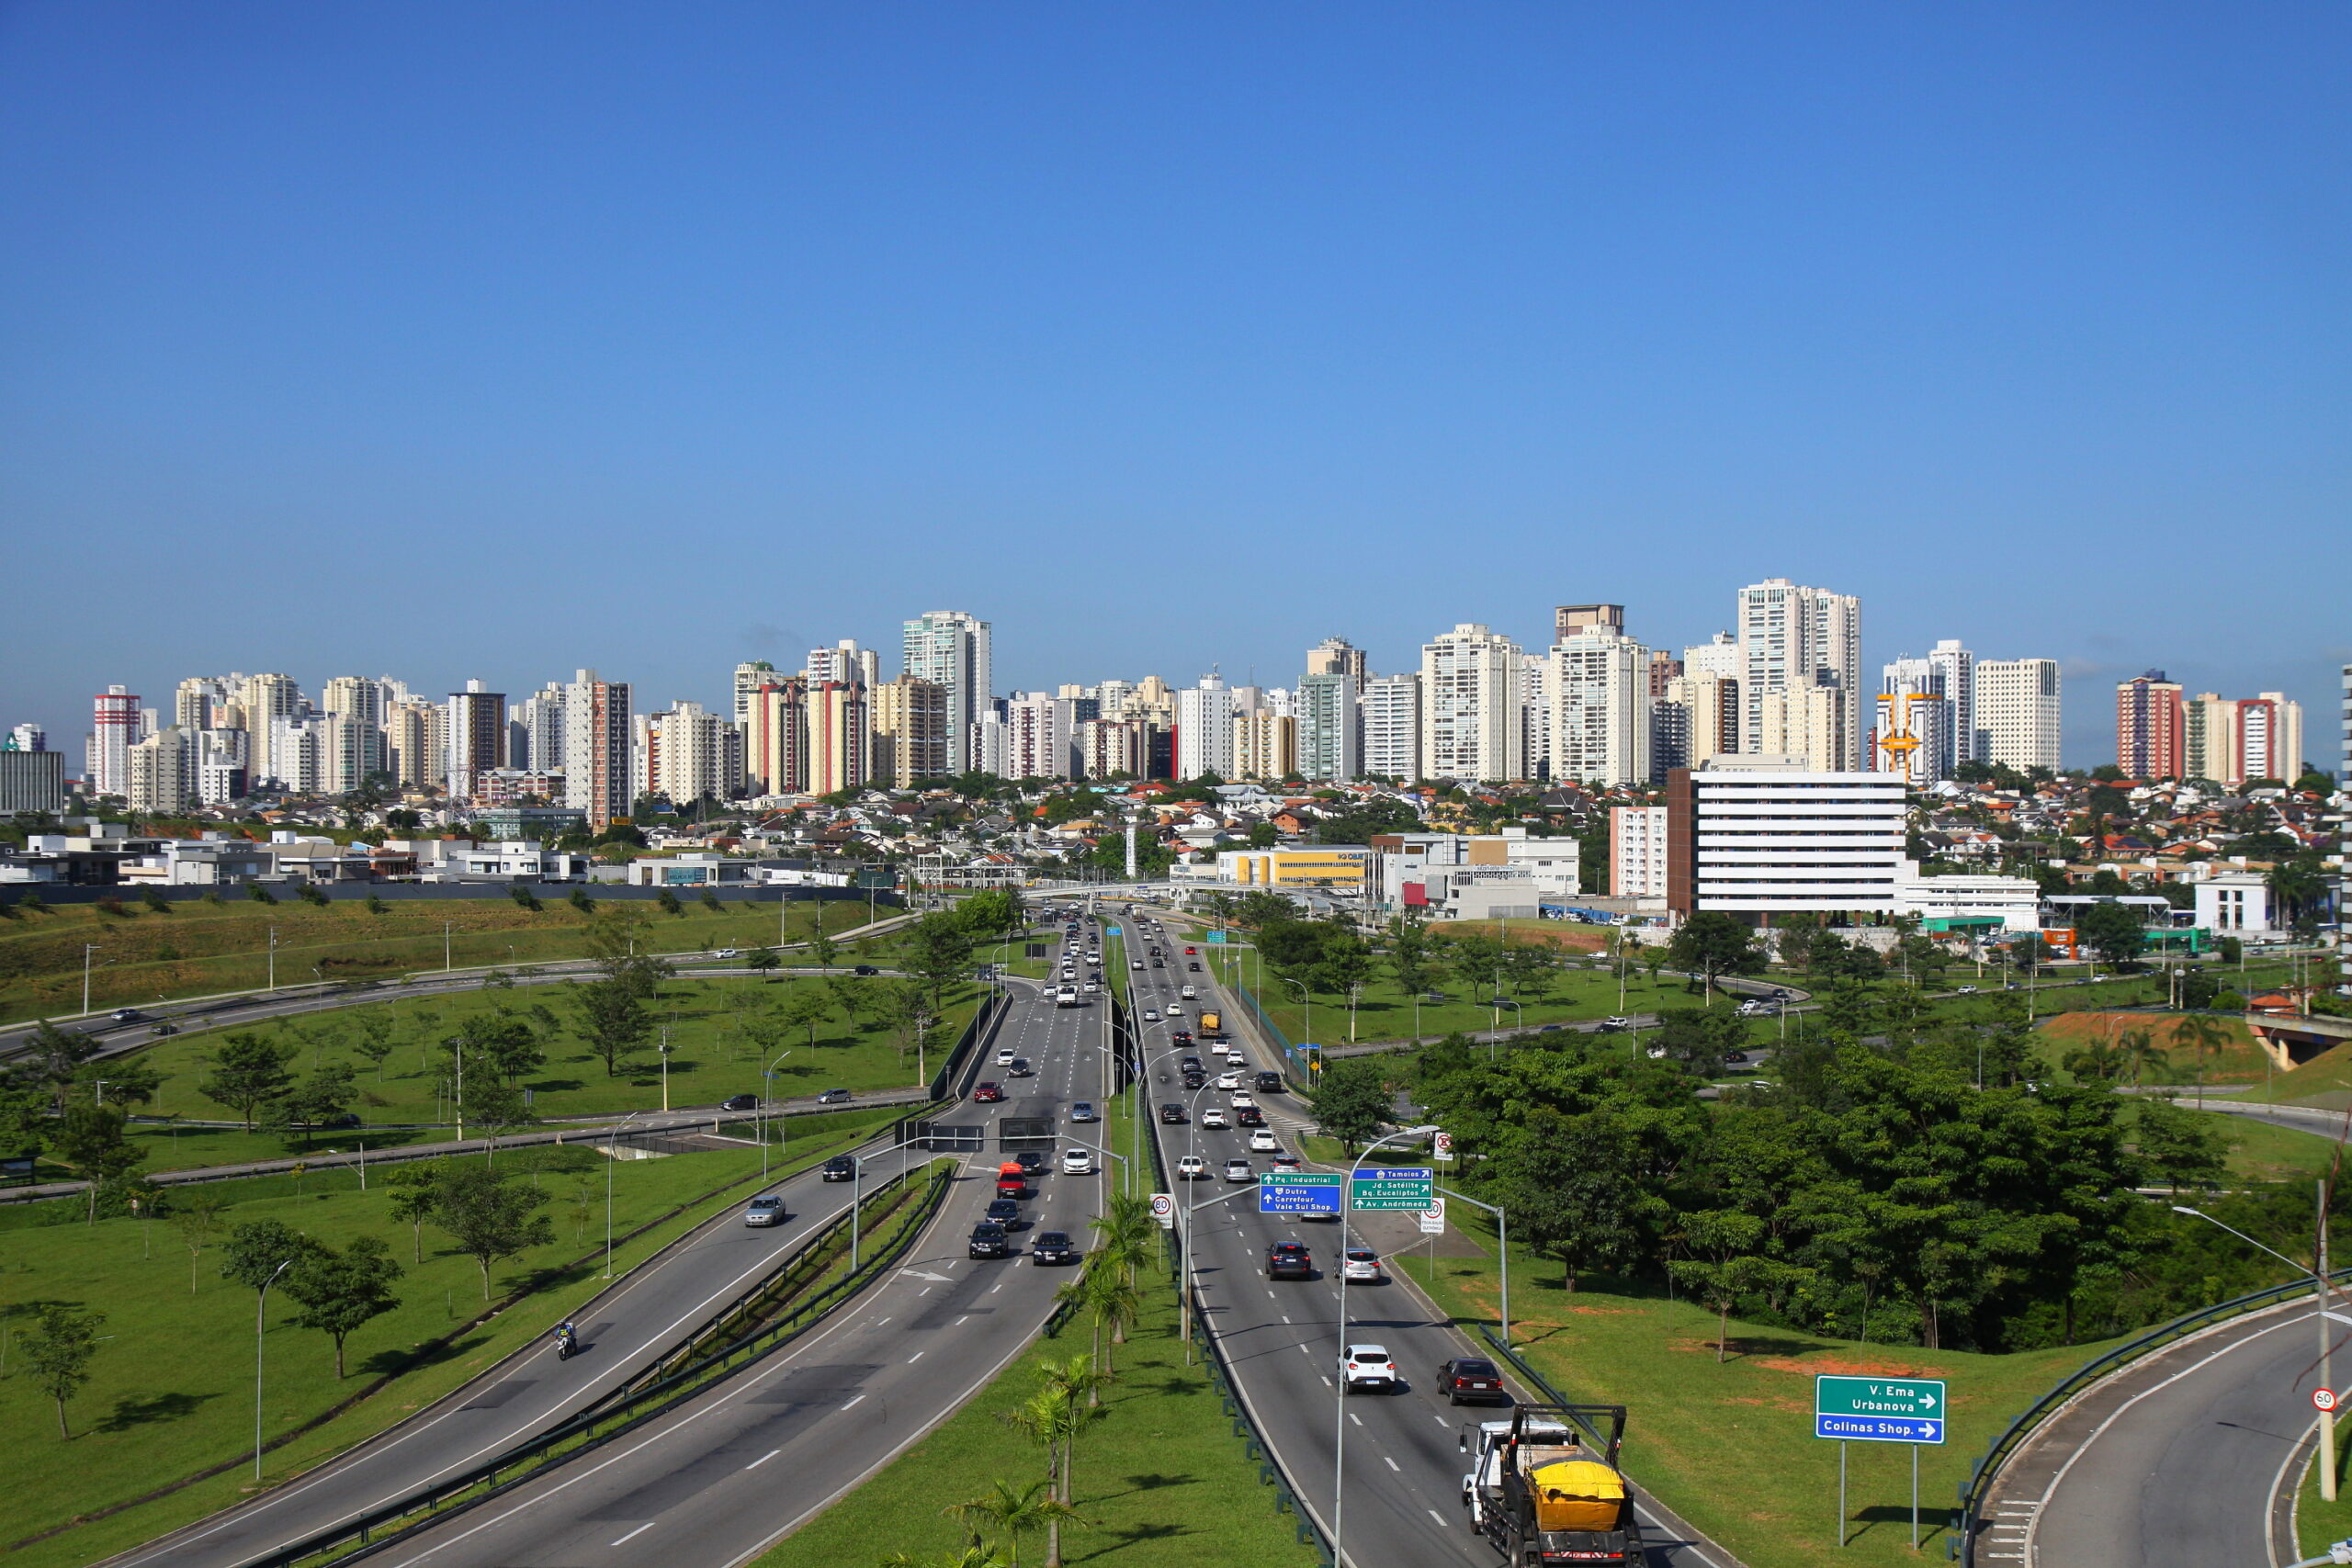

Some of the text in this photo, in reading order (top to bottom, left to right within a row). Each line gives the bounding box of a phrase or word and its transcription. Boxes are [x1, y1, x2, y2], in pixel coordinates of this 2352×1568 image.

[1869, 1385, 1914, 1397] V. Ema
[2317, 1393, 2331, 1403] 60
[1853, 1399, 1914, 1412] Urbanova
[1824, 1420, 1914, 1436] Colinas Shop.
